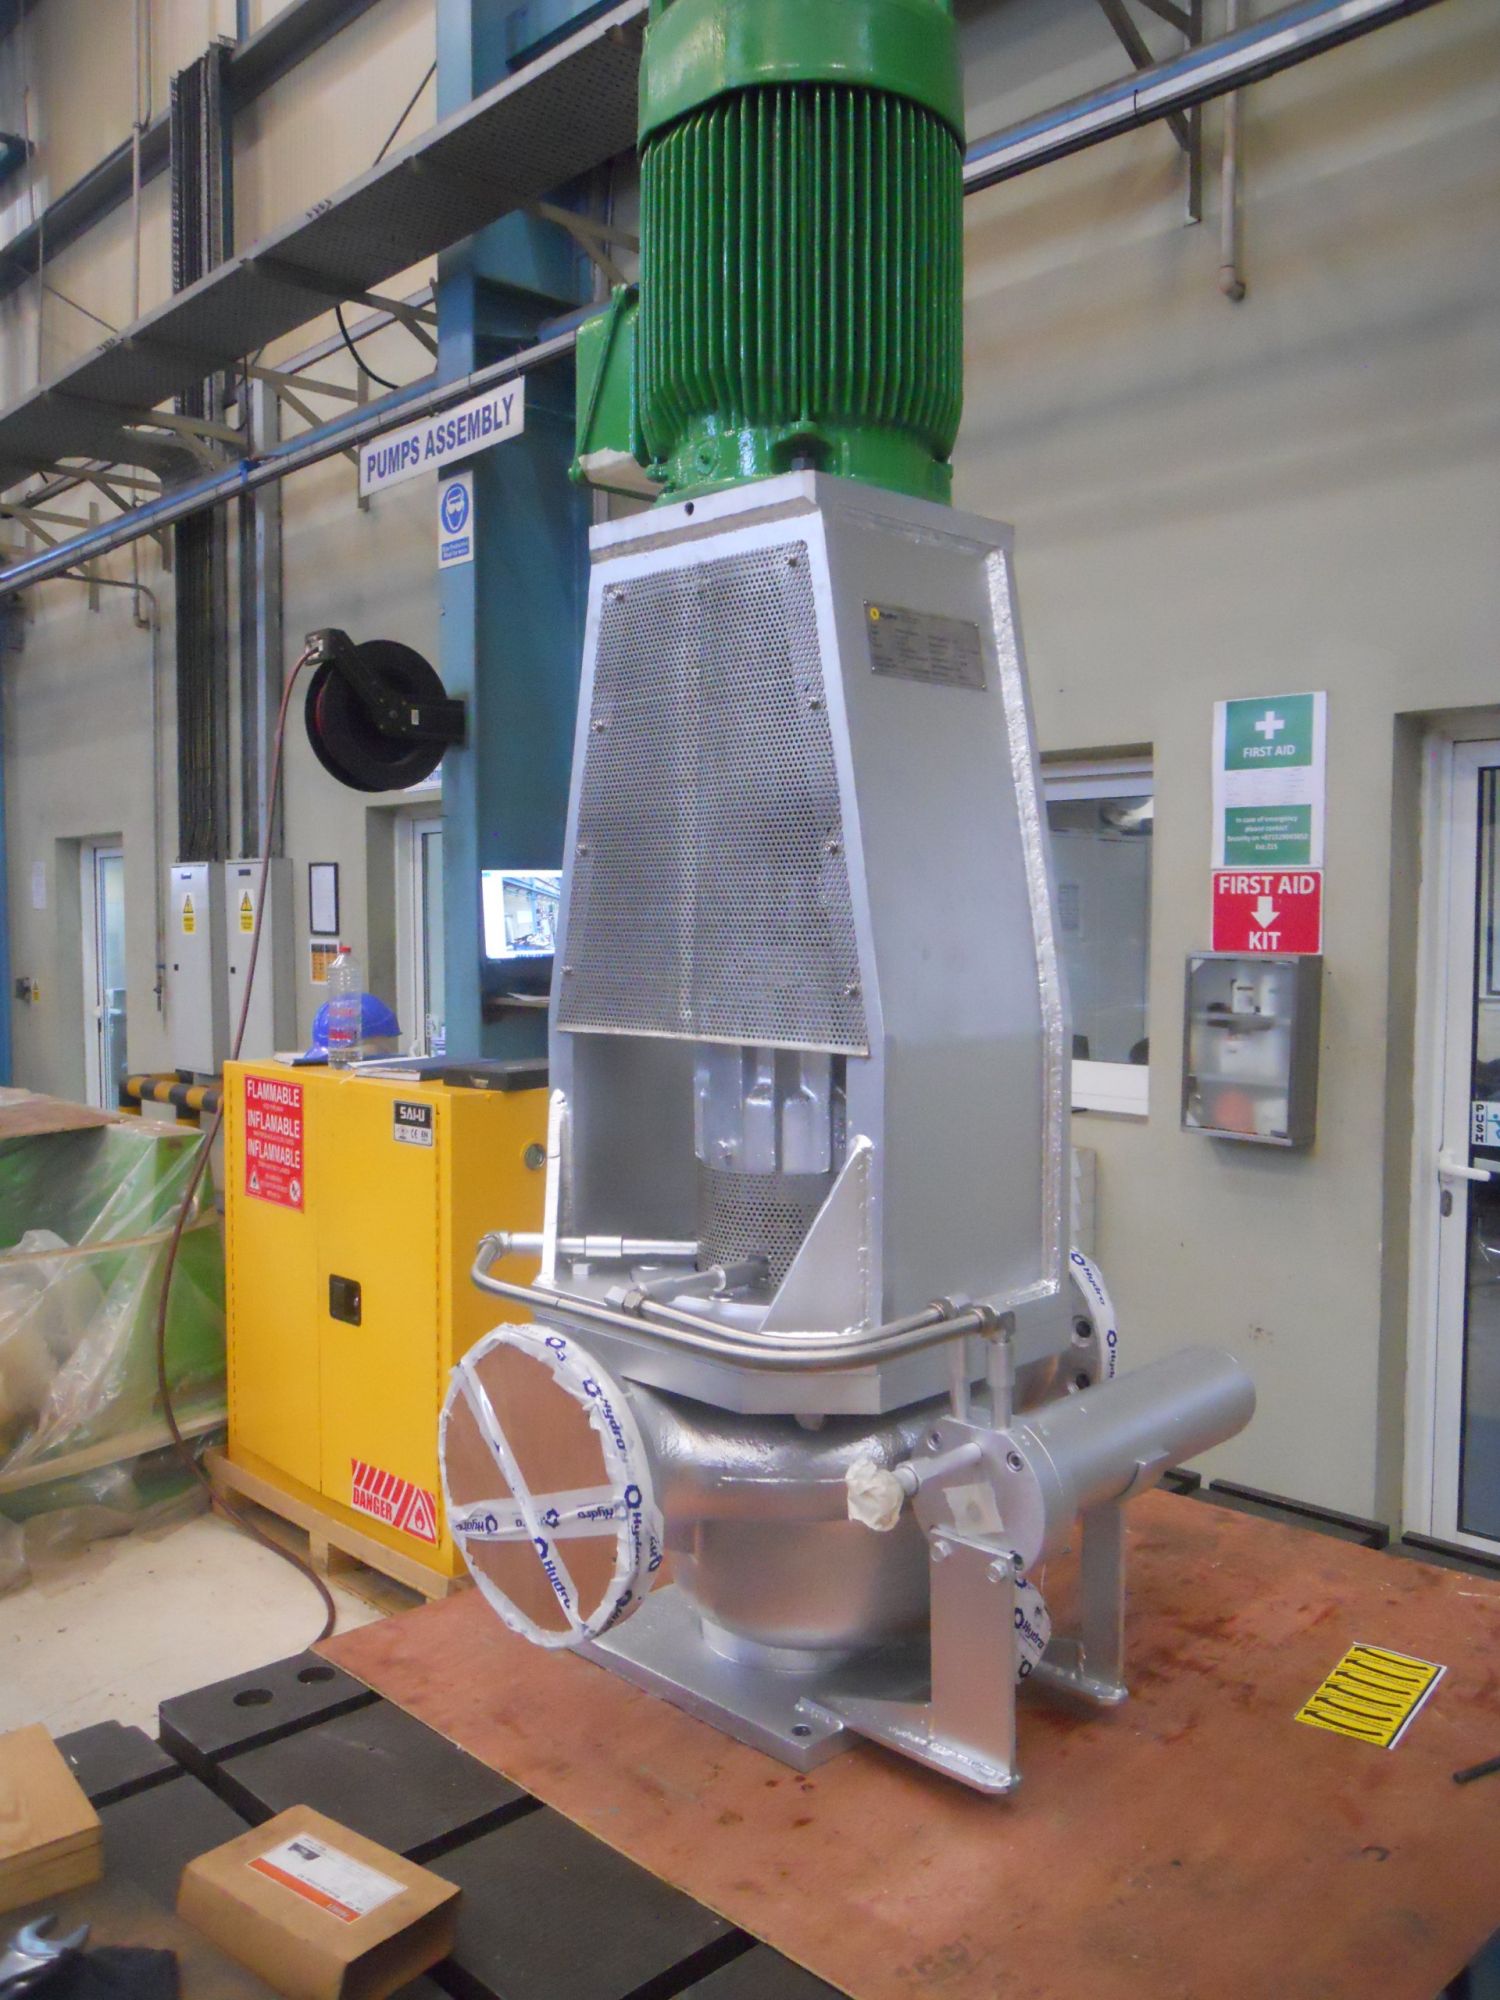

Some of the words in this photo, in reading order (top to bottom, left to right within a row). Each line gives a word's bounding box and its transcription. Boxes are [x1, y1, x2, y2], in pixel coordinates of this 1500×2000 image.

[367, 435, 420, 482] PUMPS
[424, 393, 514, 460] ASSEMBLY
[1243, 746, 1273, 758] FIRST
[1274, 744, 1295, 756] AID
[1219, 876, 1273, 895] FIRST
[1277, 875, 1315, 895] AID
[1249, 931, 1281, 950] KIT
[247, 1079, 300, 1108] FLAMMABLE
[247, 1109, 300, 1139] INFLAMABLE
[1475, 1103, 1485, 1143] PUSH
[247, 1138, 300, 1169] INFLAMMABLE
[602, 1399, 626, 1450] Hydro
[352, 1487, 393, 1521] DANGER
[577, 1506, 614, 1521] Hydro
[1022, 1620, 1045, 1649] Hydro
